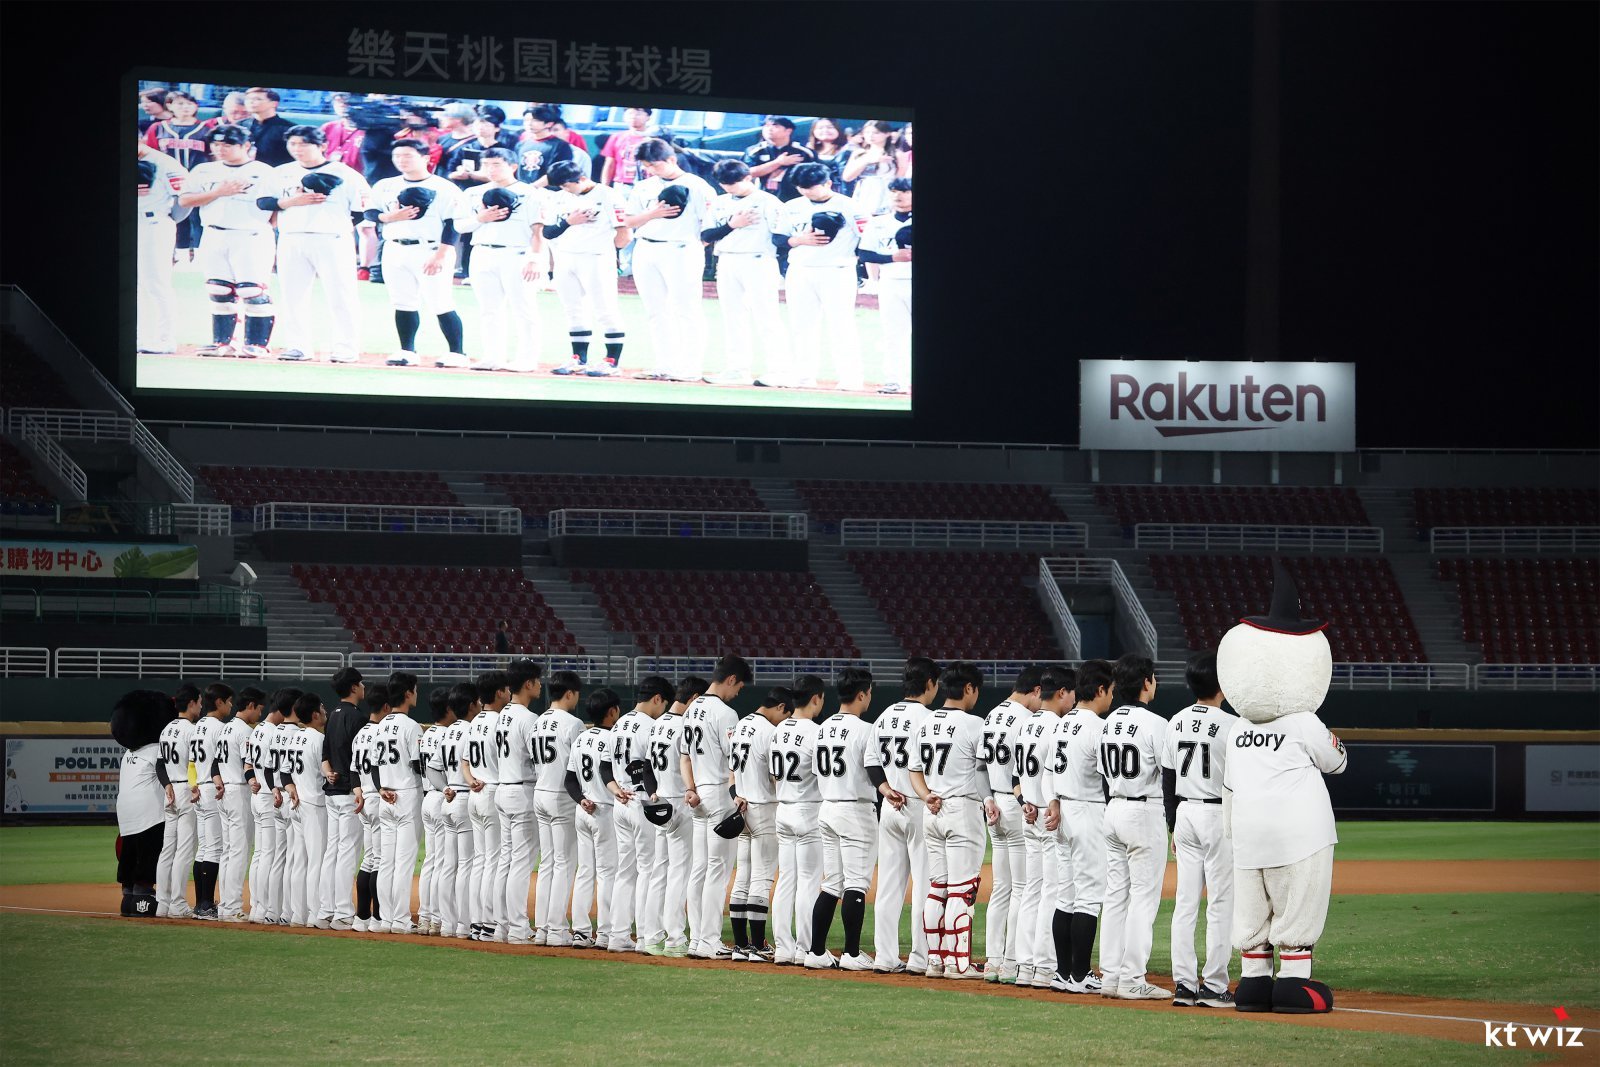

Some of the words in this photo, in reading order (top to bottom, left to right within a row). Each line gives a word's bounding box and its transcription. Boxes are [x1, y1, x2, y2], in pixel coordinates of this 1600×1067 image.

[347, 27, 714, 95] 樂天桃園棒球場
[1109, 371, 1327, 422] Rakuten
[683, 724, 705, 756] 92
[1175, 720, 1220, 738] 이강철
[54, 756, 98, 770] POOL
[100, 756, 121, 770] PA
[190, 739, 207, 763] 35
[216, 739, 229, 764] 29
[287, 749, 305, 775] 55
[376, 738, 401, 765] 25
[440, 744, 459, 773] 14
[613, 735, 632, 765] 41
[816, 744, 847, 778] 03
[878, 735, 910, 769] 33
[920, 742, 954, 776] 97
[983, 731, 1012, 766] 56
[1054, 740, 1068, 774] 5
[1100, 742, 1140, 779] 100
[1177, 740, 1211, 779] 71
[581, 753, 594, 783] 8
[771, 749, 803, 783] 02
